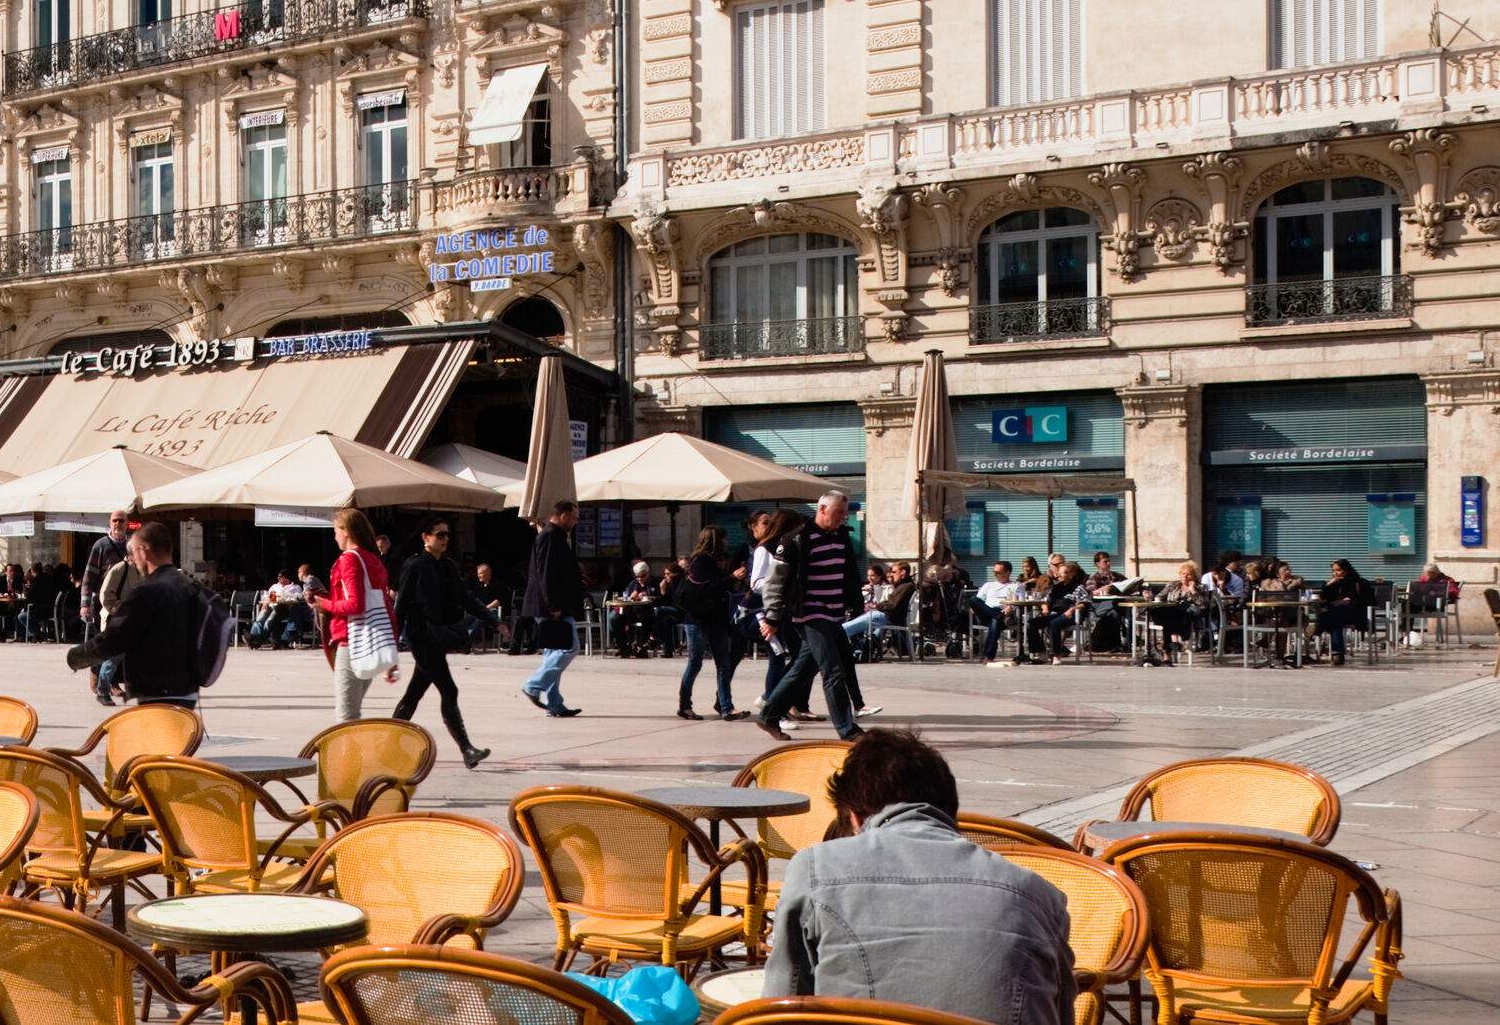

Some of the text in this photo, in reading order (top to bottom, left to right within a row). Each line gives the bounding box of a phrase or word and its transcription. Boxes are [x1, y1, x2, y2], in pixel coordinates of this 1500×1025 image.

[435, 224, 548, 255] AGENCE de
[429, 251, 556, 283] la COMEDIE
[269, 331, 373, 357] BAR BRASSERIE
[61, 338, 222, 377] le Café 1893
[94, 403, 280, 438] Le Café Riche
[998, 413, 1060, 437] CIC
[141, 438, 205, 457] 1893
[1249, 447, 1374, 461] Société Bordelaise
[973, 457, 1081, 470] Société Bordelaise
[1086, 523, 1111, 535] 3,6%
